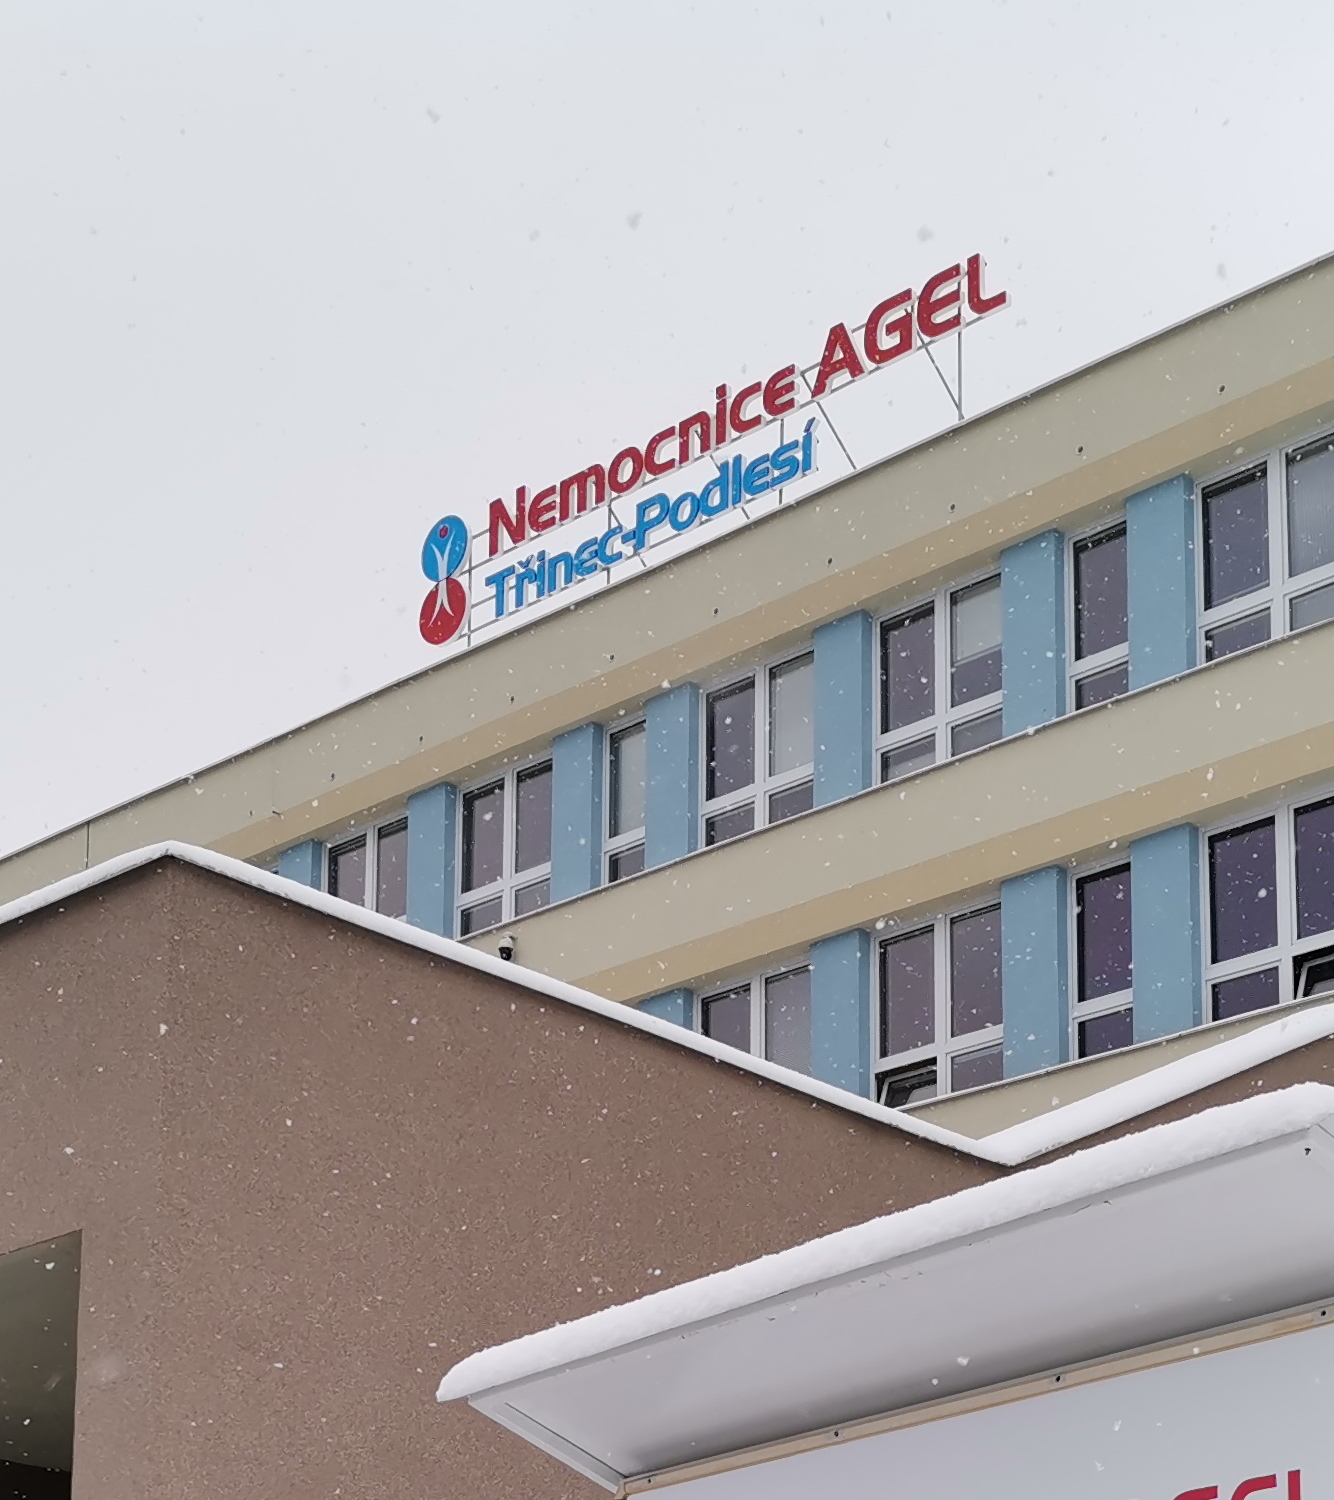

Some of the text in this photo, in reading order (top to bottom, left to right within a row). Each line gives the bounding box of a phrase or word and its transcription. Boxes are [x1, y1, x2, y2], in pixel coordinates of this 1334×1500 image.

[485, 417, 817, 619] Třinec-Podlesí
[488, 253, 1007, 557] Nemocnice AGEL
